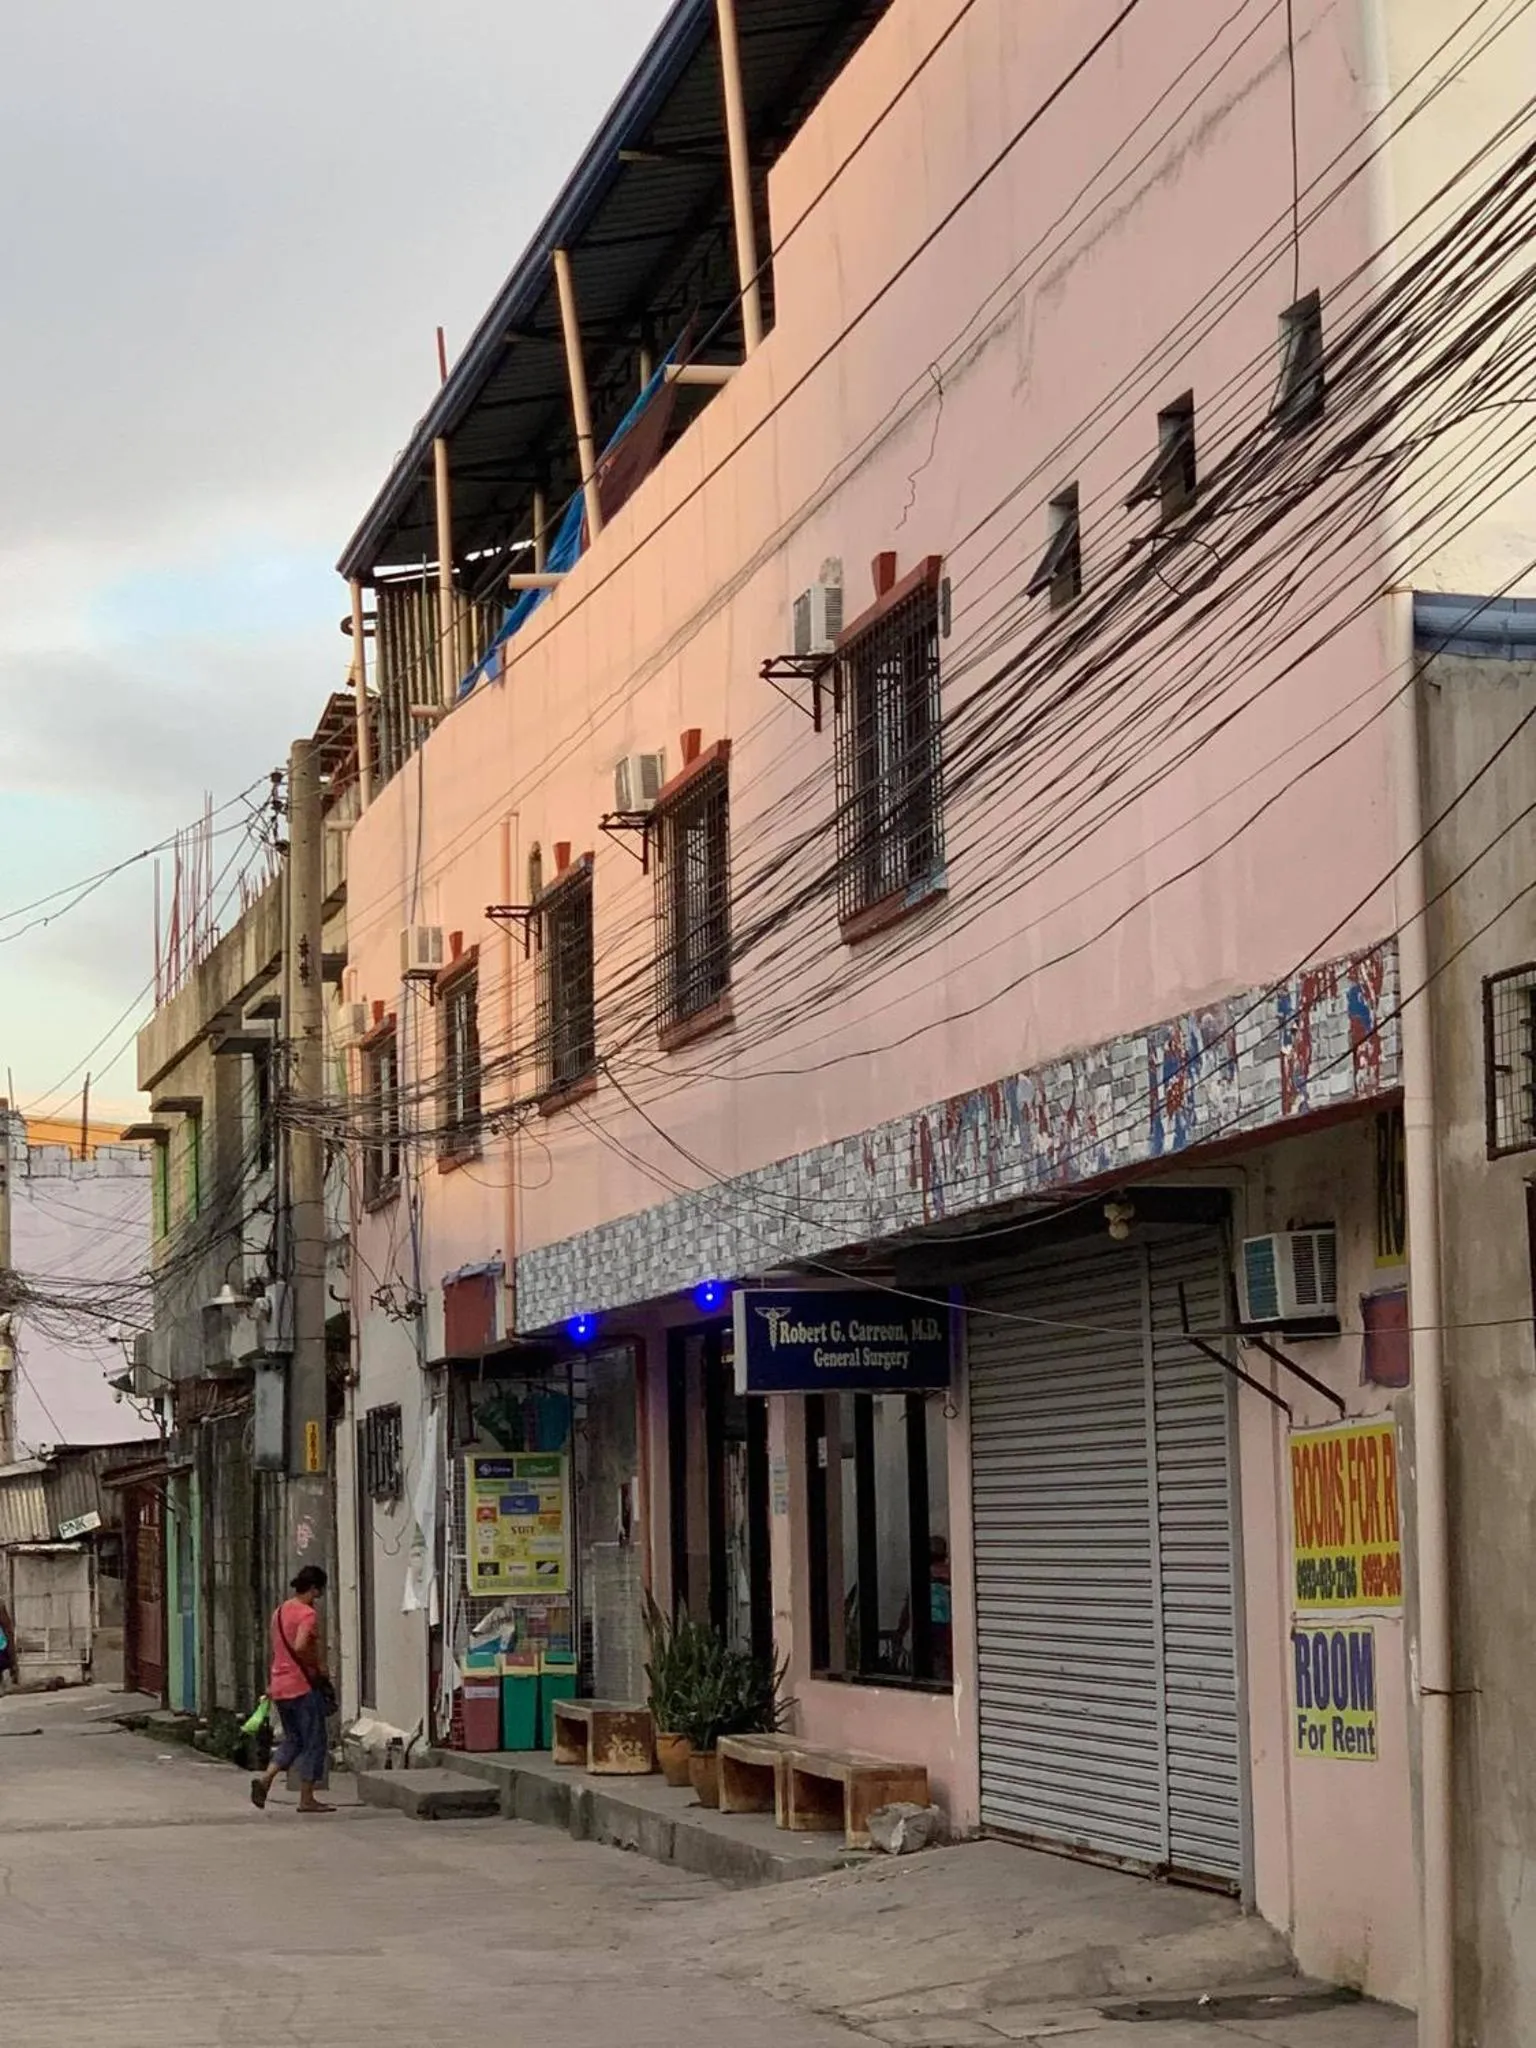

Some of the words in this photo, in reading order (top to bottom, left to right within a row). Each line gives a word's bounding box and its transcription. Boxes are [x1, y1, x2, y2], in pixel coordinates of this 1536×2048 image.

[779, 1321, 827, 1344] Robert
[831, 1320, 846, 1342] G.
[849, 1319, 908, 1345] Carreon,
[911, 1318, 942, 1341] M.D.
[813, 1347, 860, 1368] General
[862, 1347, 910, 1371] Surgery
[1291, 1438, 1346, 1550] ROOMS
[1347, 1435, 1382, 1545] FOR
[1295, 1631, 1375, 1712] ROOM
[1297, 1714, 1326, 1752] For
[1332, 1716, 1376, 1756] Rent
